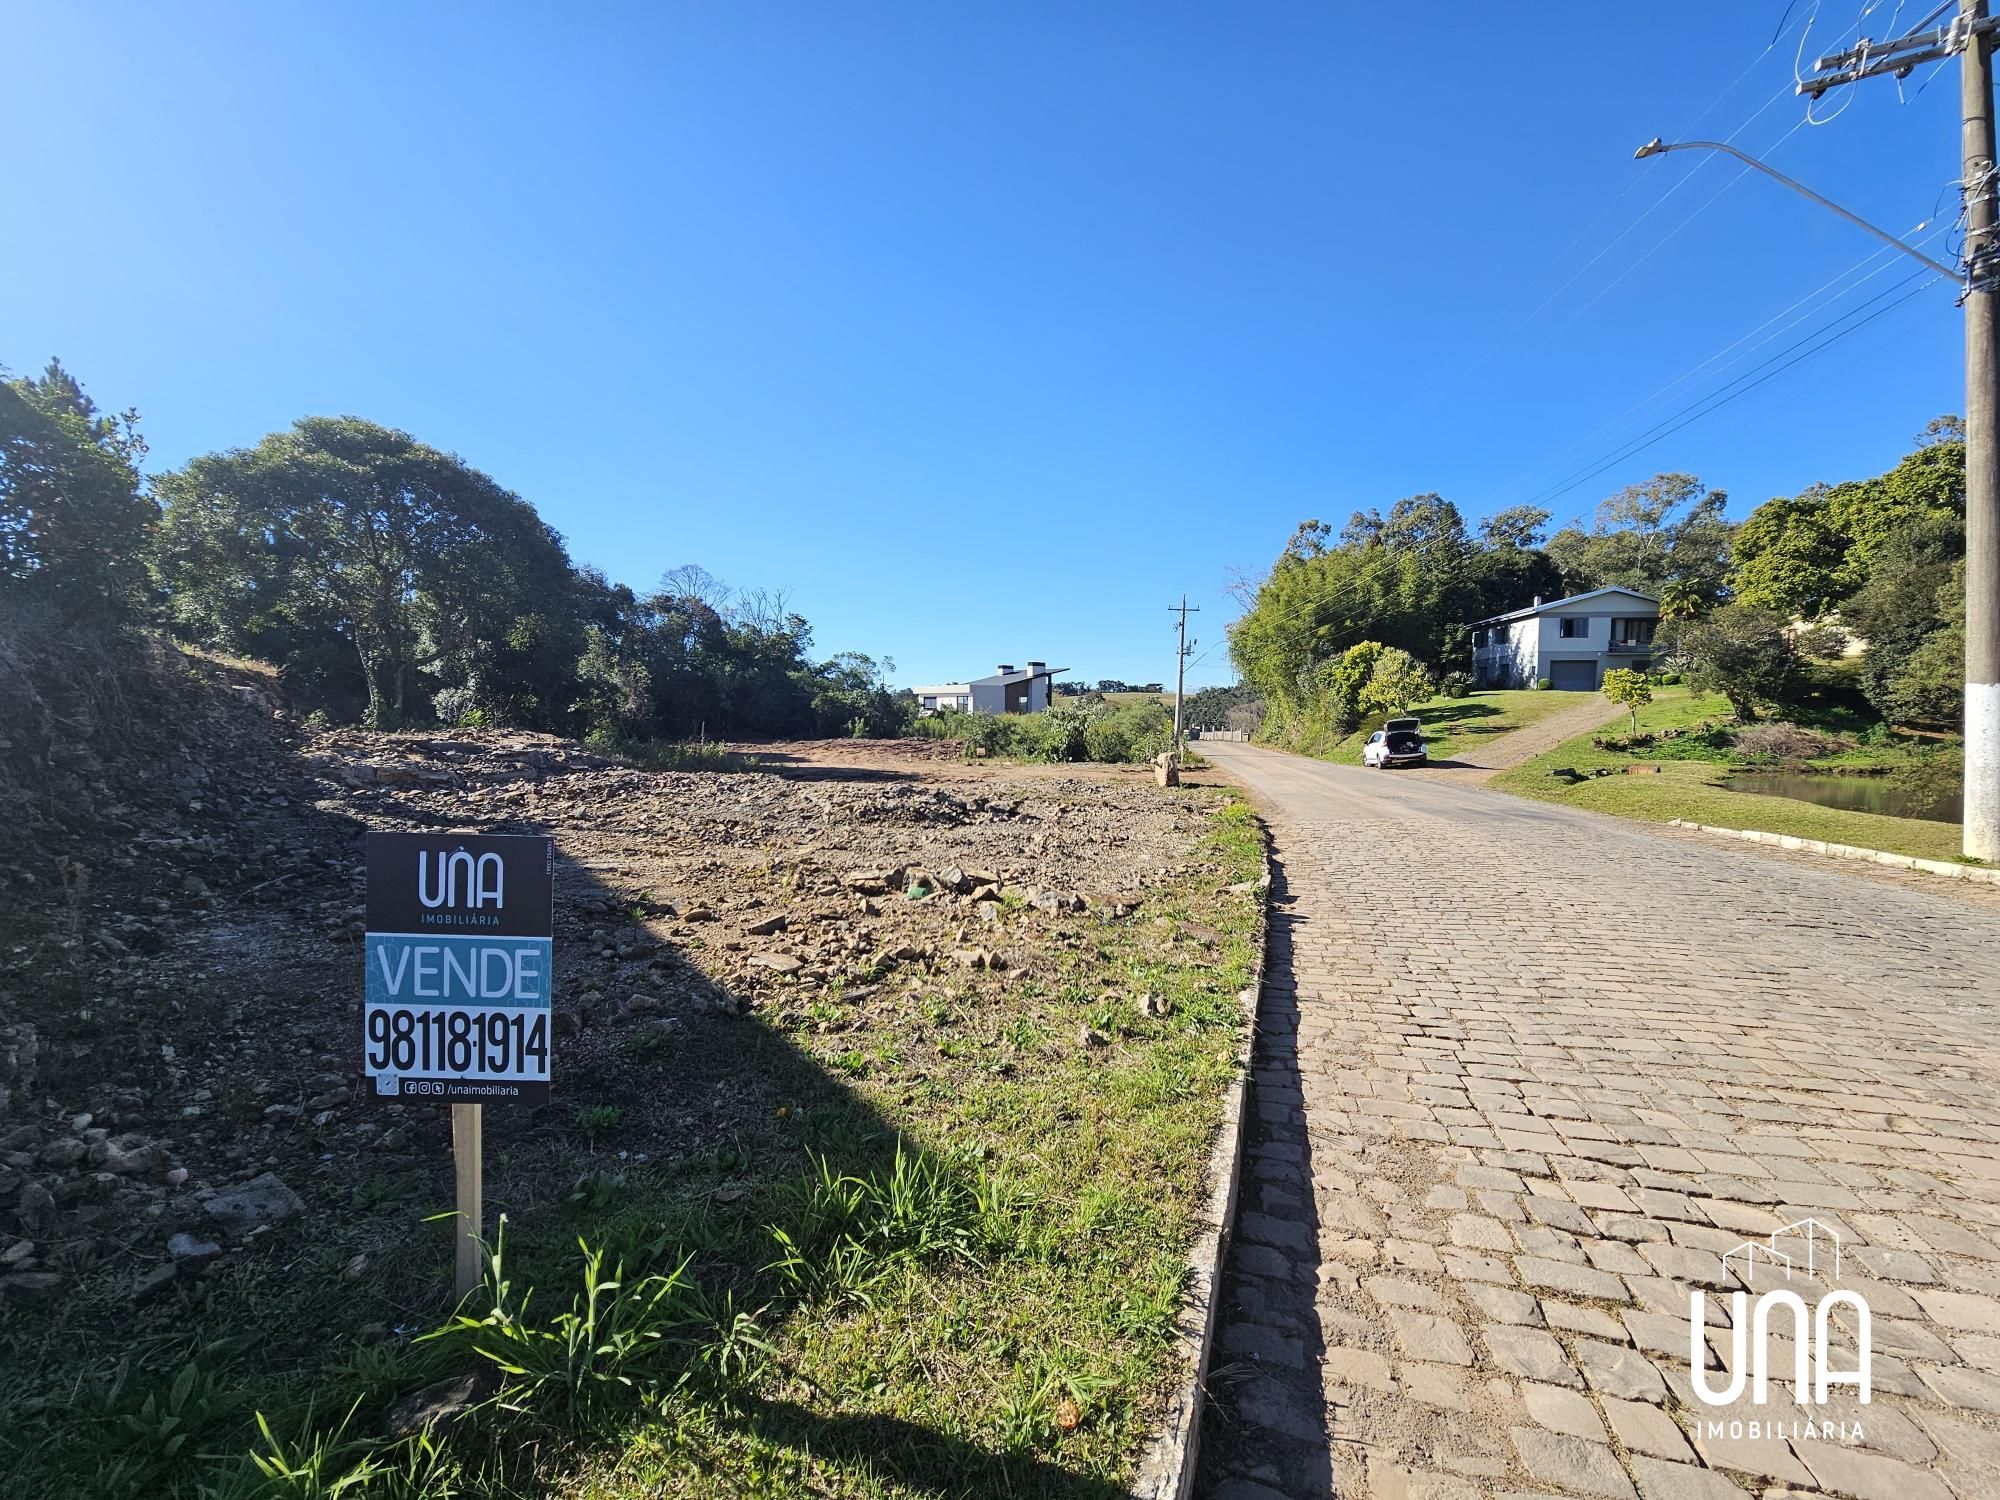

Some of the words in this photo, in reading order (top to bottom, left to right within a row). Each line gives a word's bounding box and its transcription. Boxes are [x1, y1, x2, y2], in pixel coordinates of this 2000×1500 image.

[418, 850, 504, 909] UNA
[421, 913, 501, 926] IMOBILIÁRIA
[376, 944, 541, 999] VENDE
